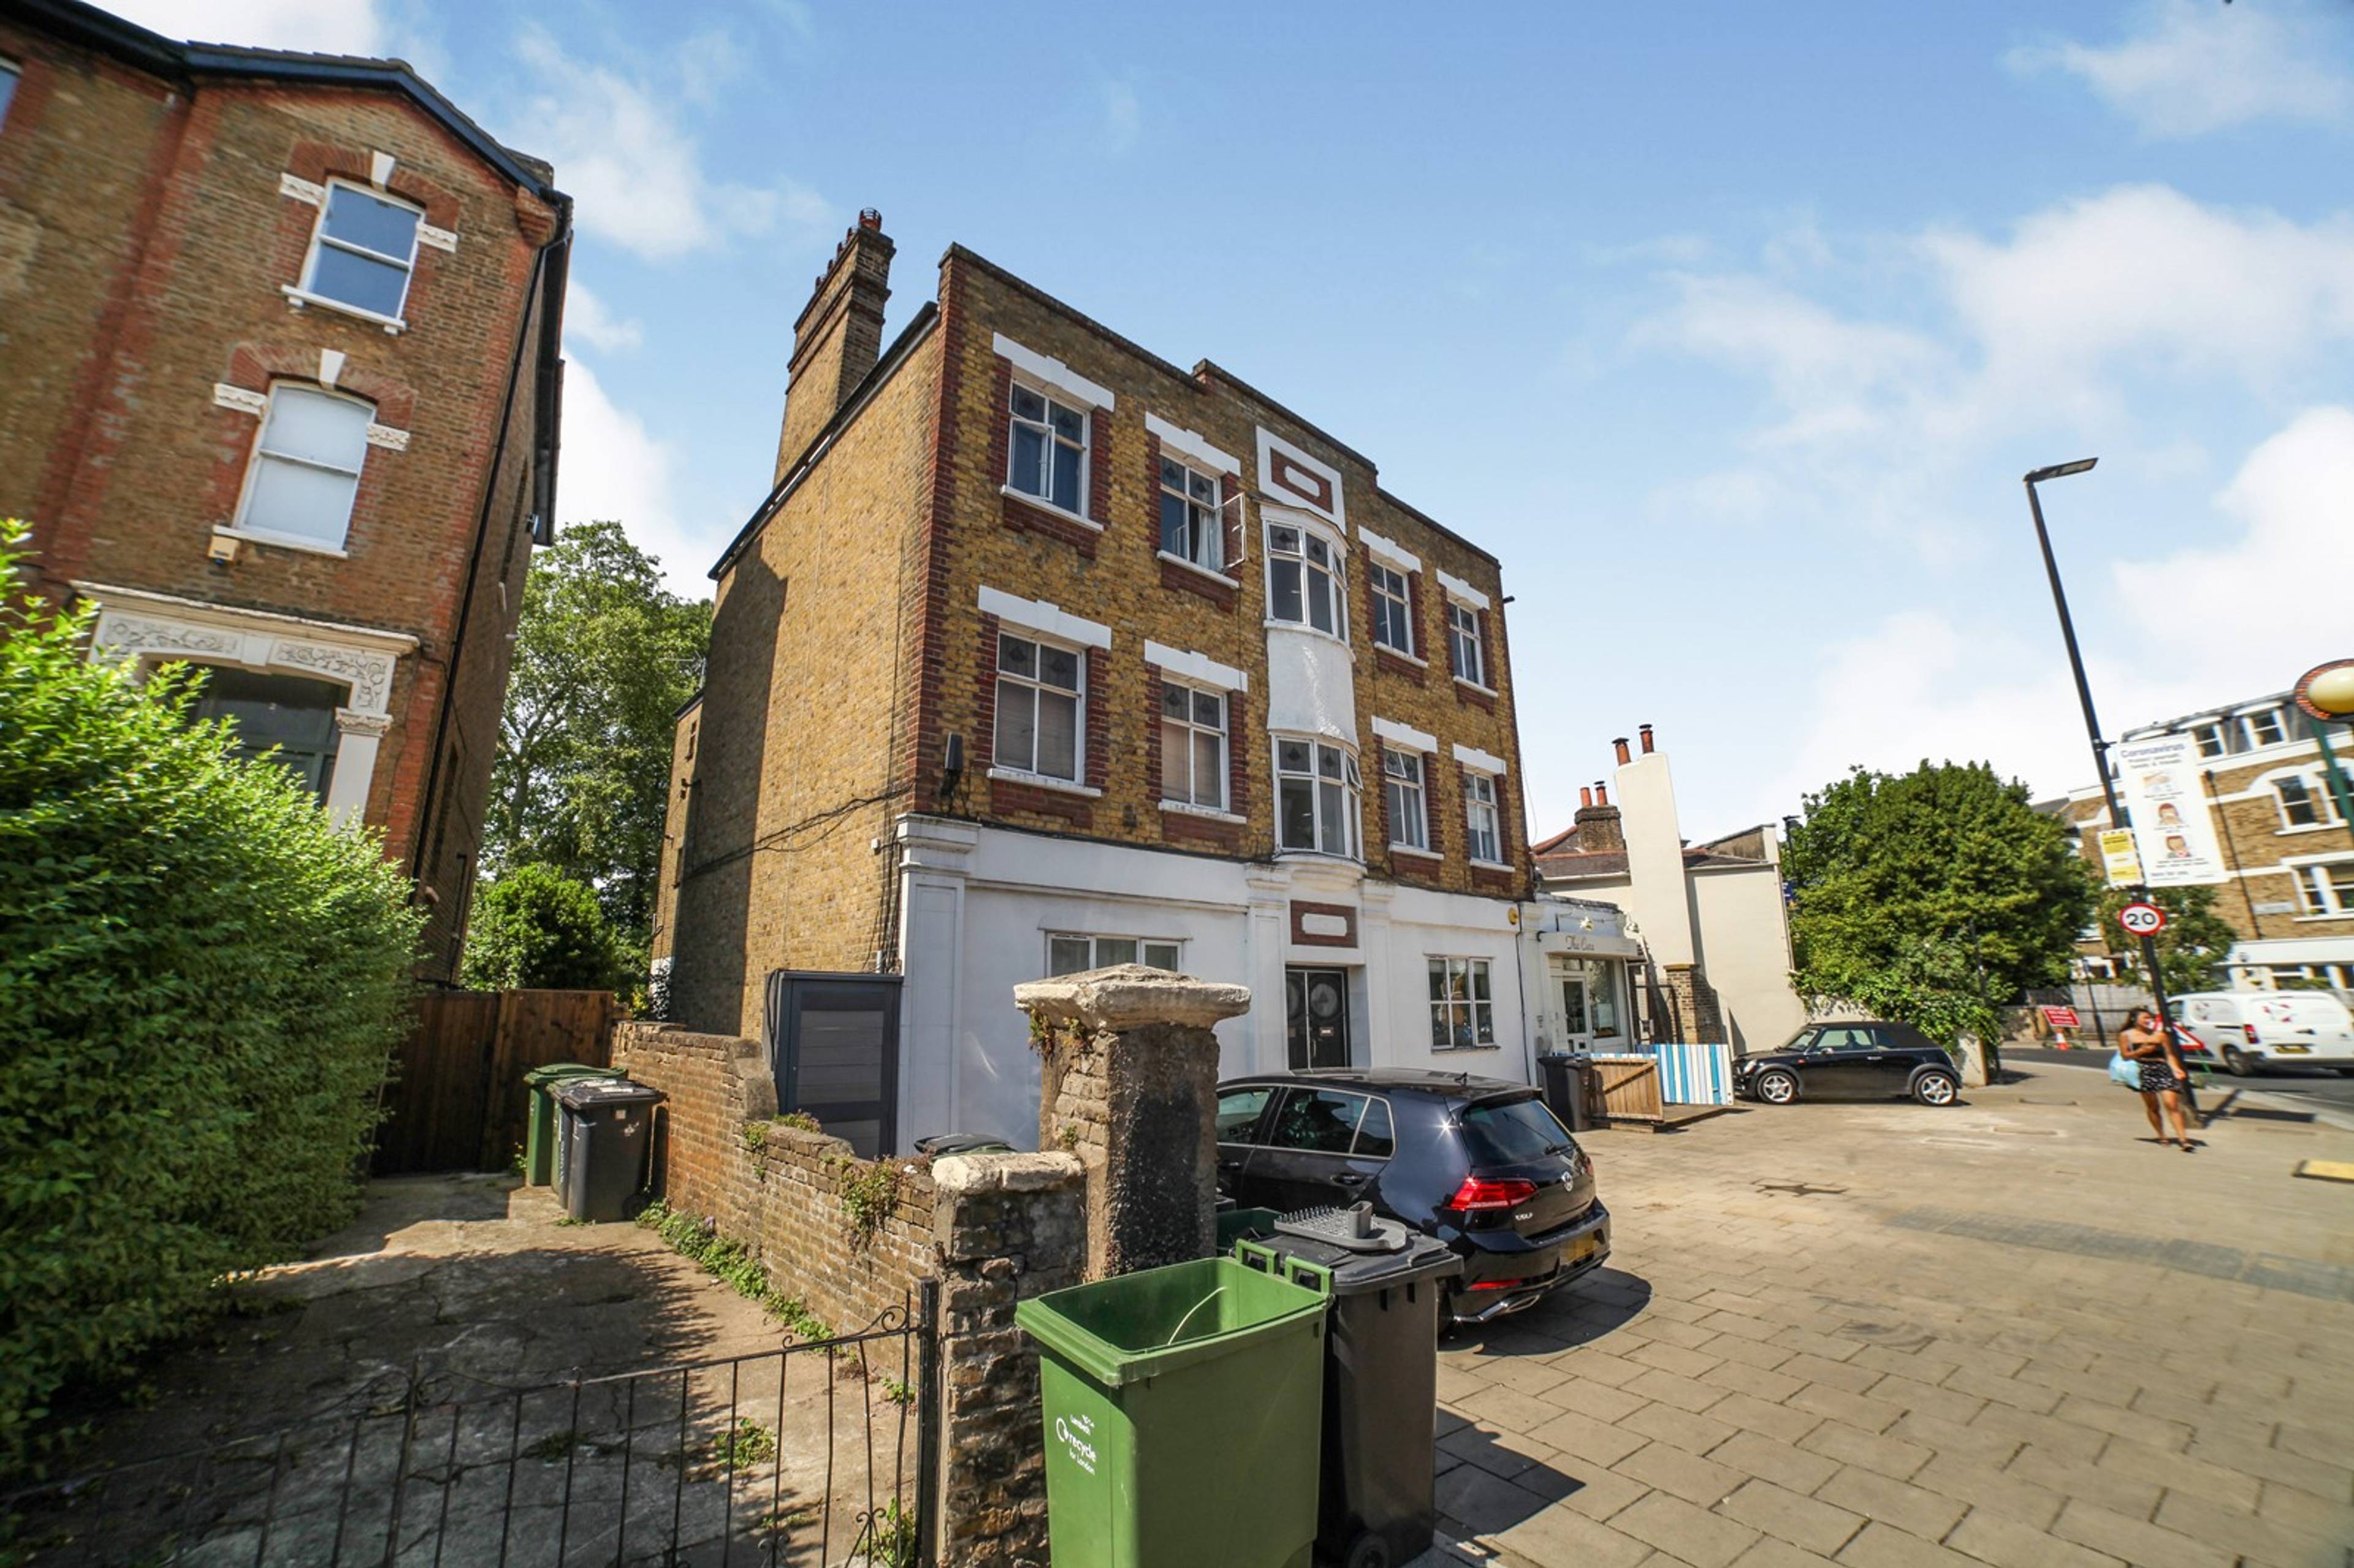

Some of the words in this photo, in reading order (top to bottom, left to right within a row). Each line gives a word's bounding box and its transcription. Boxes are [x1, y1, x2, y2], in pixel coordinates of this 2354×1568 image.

[2121, 744, 2185, 758] Coronavirus
[2126, 912, 2156, 926] 20
[1069, 1433, 1096, 1463] recycle
[1077, 1453, 1095, 1477] London
